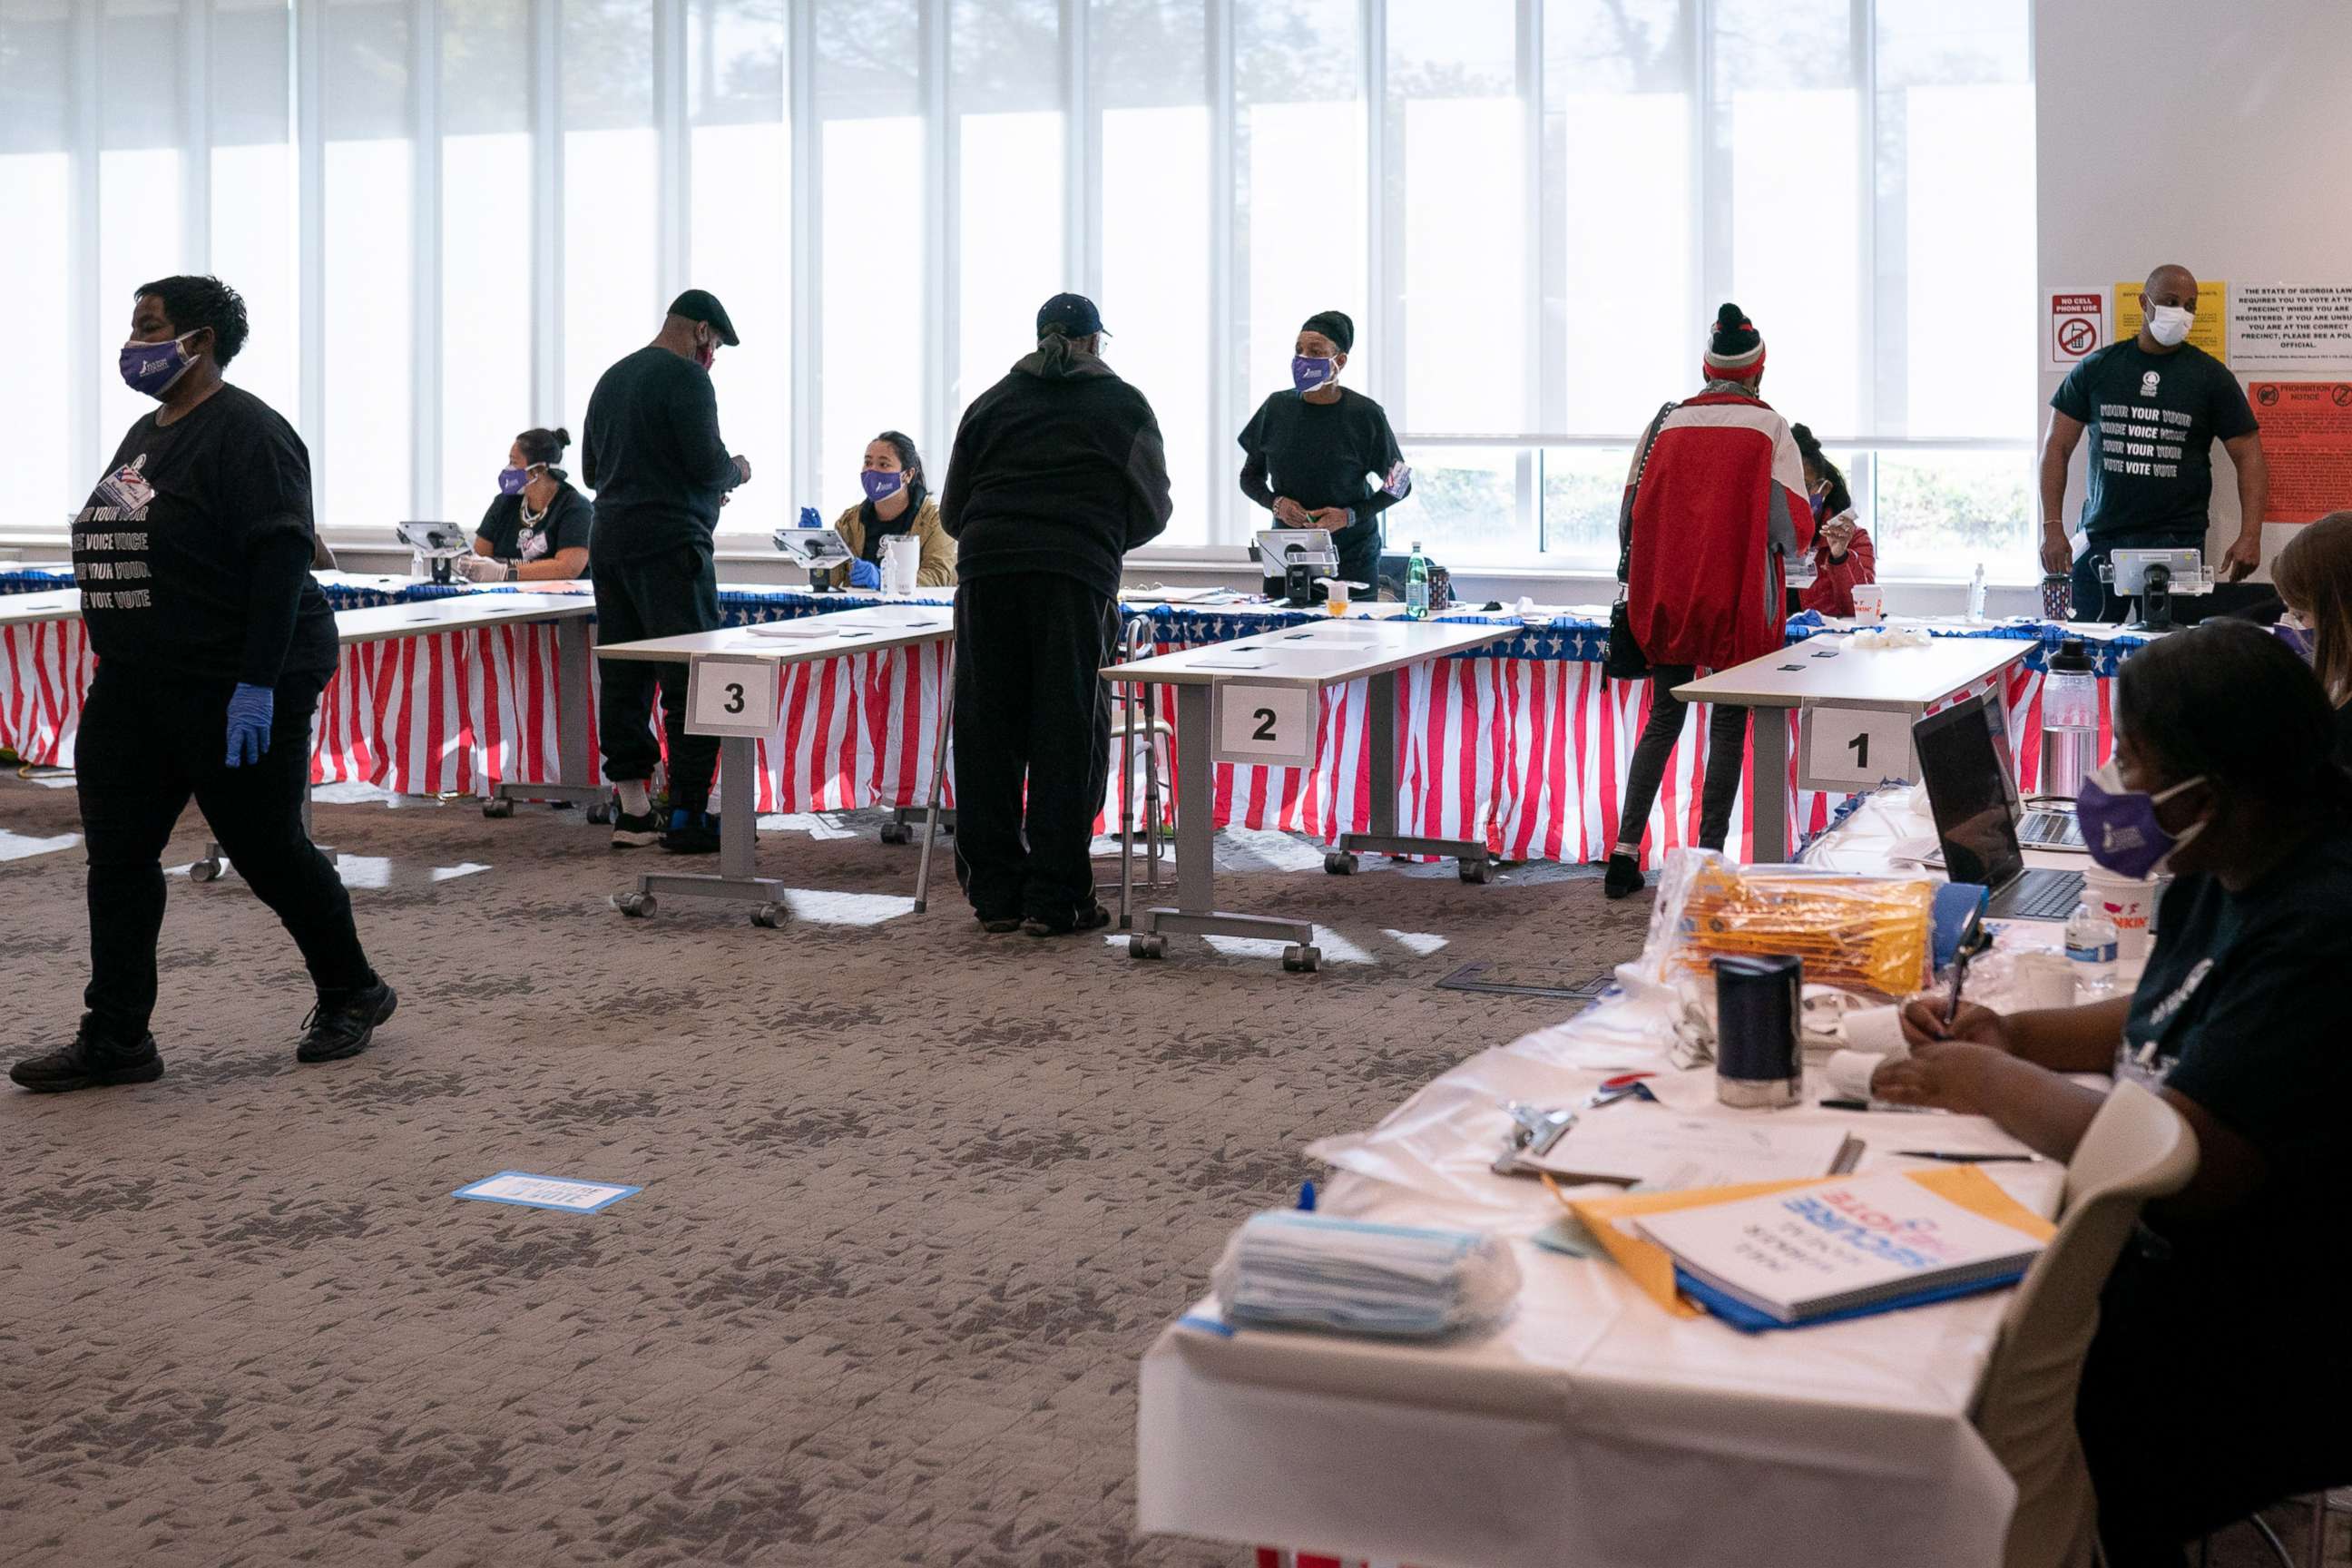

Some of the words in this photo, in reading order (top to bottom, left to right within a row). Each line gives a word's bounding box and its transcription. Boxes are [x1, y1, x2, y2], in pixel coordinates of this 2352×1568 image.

[2290, 393, 2320, 401] NOTICE
[2131, 407, 2160, 421] YOUR
[2128, 425, 2159, 439] VOICE
[2127, 443, 2154, 457] YOUR
[2126, 461, 2151, 475] VOTE
[93, 506, 120, 522] YOUR
[86, 534, 114, 551] VOICE
[114, 533, 150, 551] VOICE
[88, 563, 113, 580] YOUR
[90, 592, 114, 609] VOTE
[114, 589, 152, 609] VOTE
[724, 682, 745, 714] 3
[1252, 708, 1277, 741] 2
[1847, 732, 1869, 769] 1
